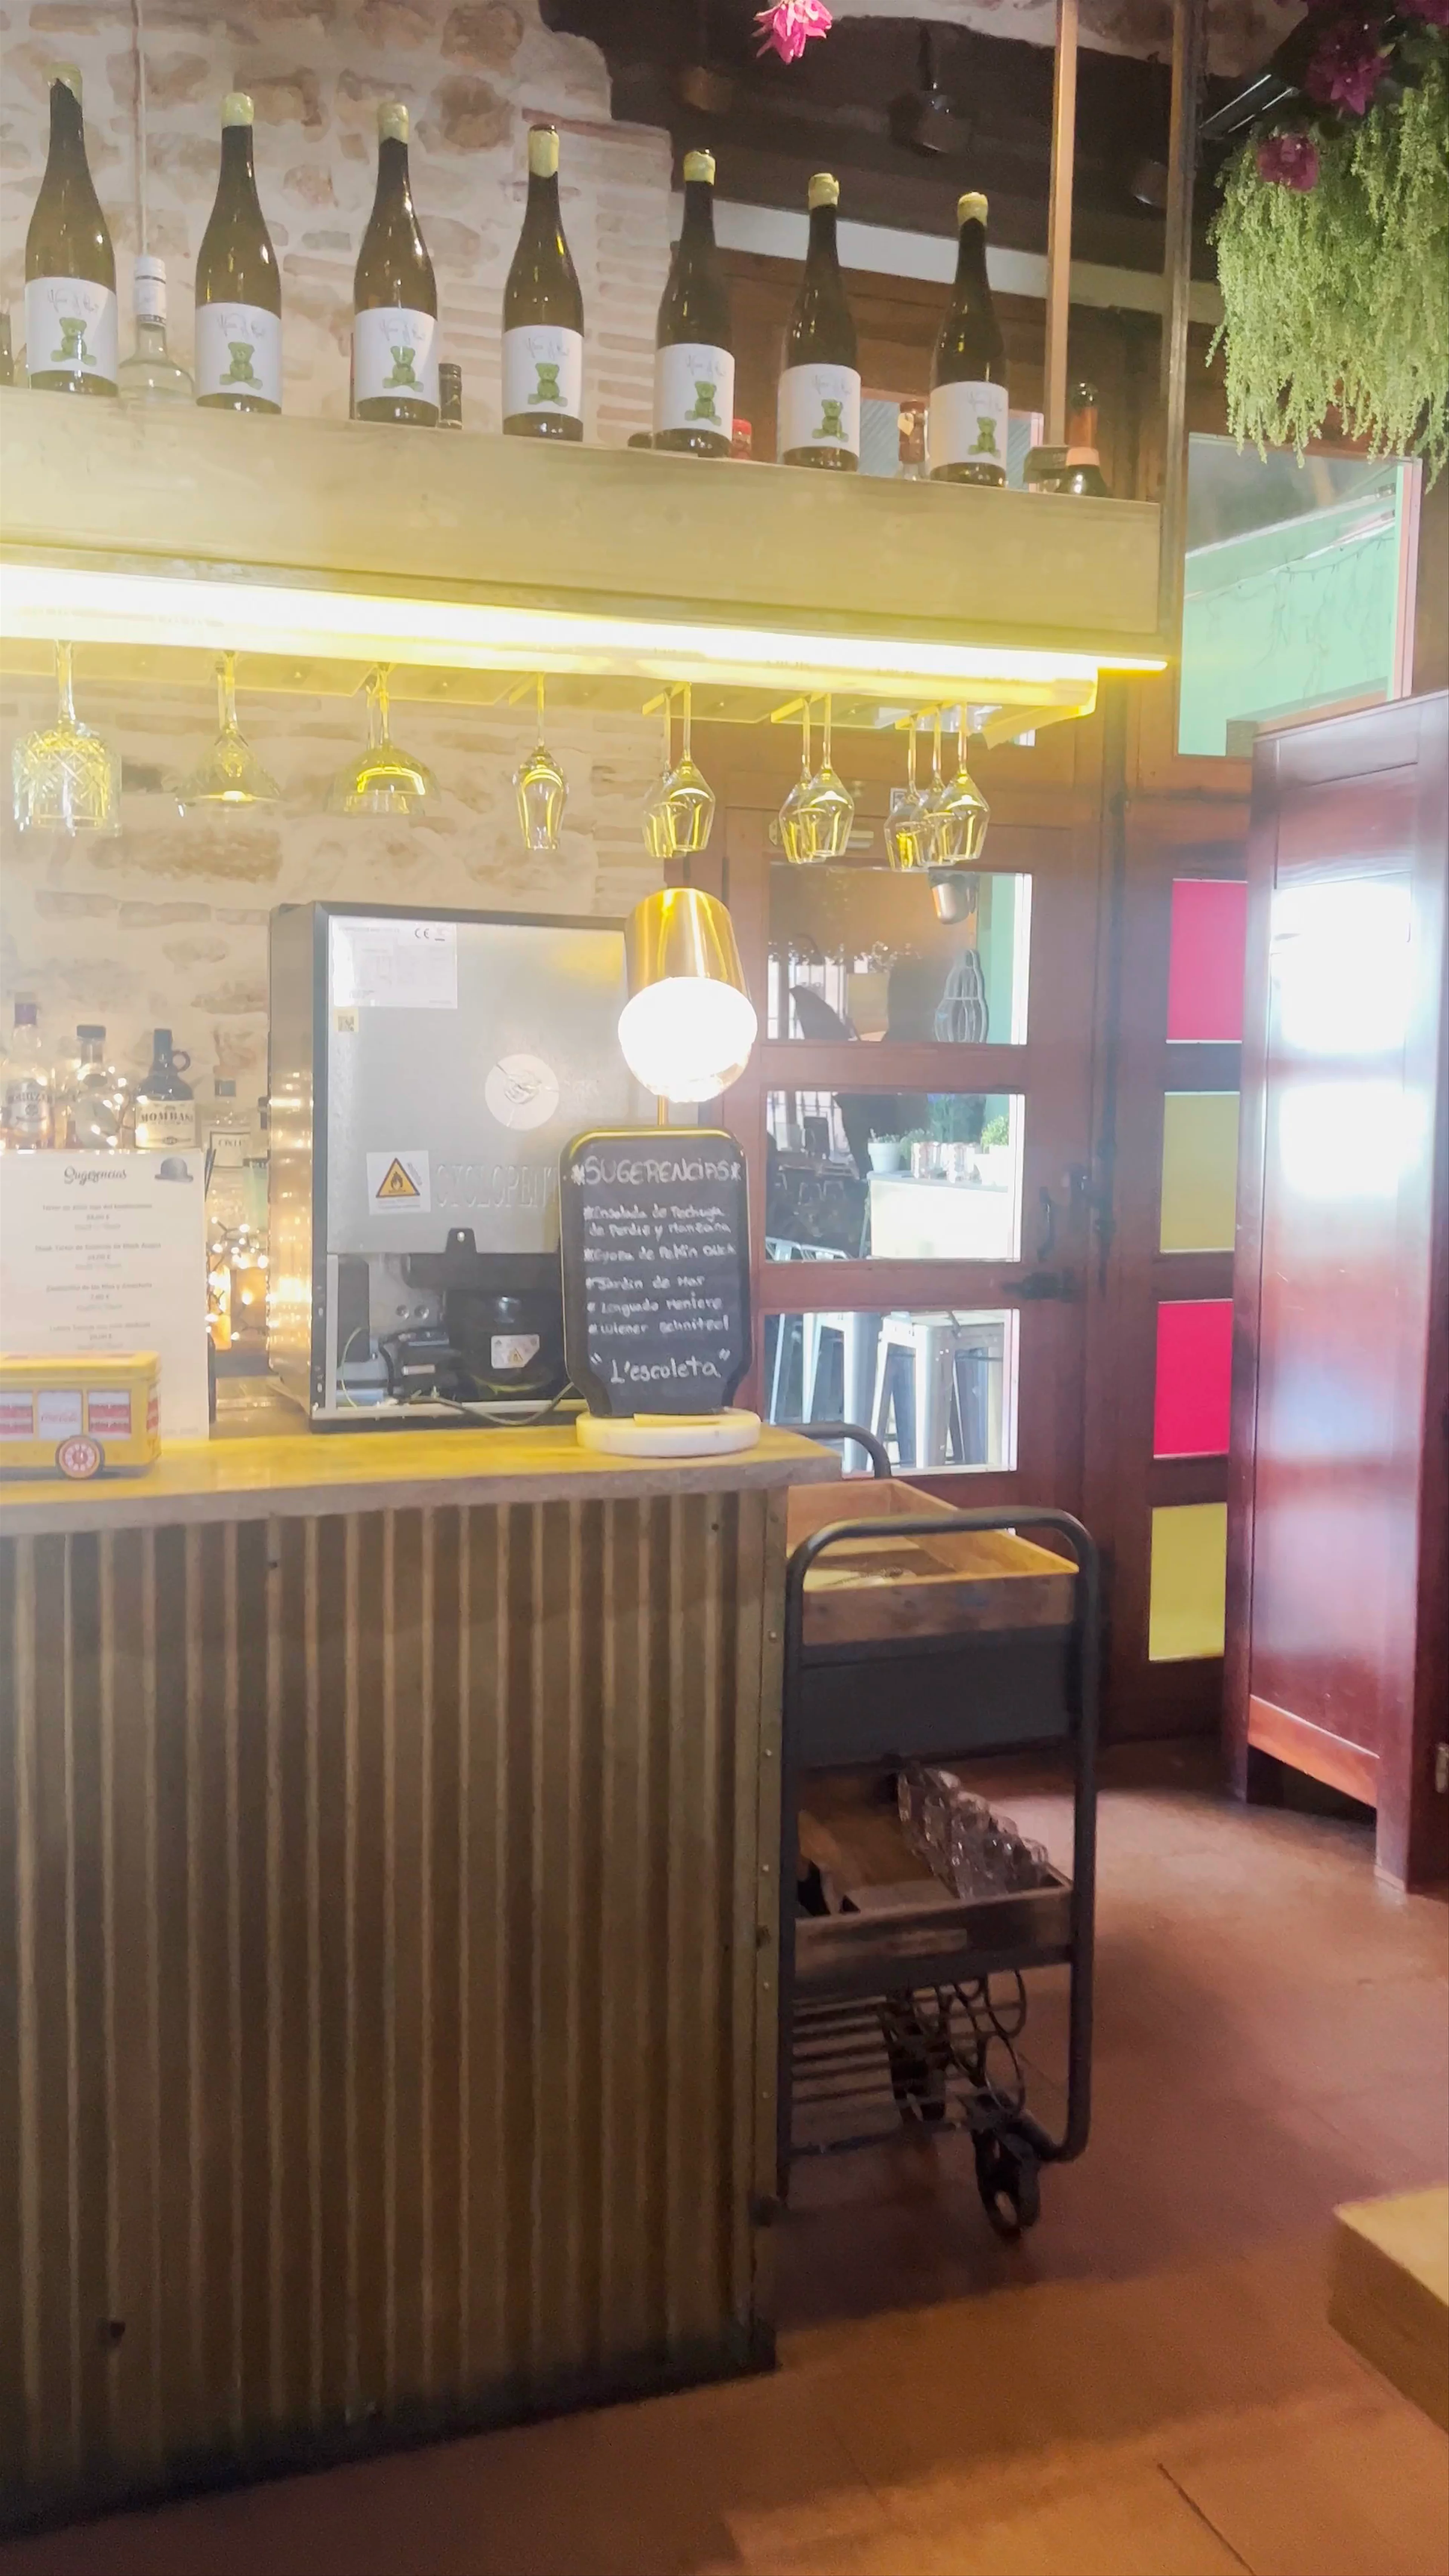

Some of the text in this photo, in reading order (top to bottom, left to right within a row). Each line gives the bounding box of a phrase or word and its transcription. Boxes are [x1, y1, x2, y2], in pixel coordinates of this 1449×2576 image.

[64, 1165, 127, 1186] Sugerencias
[652, 1203, 667, 1219] de
[589, 1222, 605, 1237] de
[654, 1224, 663, 1242] y
[638, 1245, 655, 1261] de
[652, 1275, 671, 1289] de
